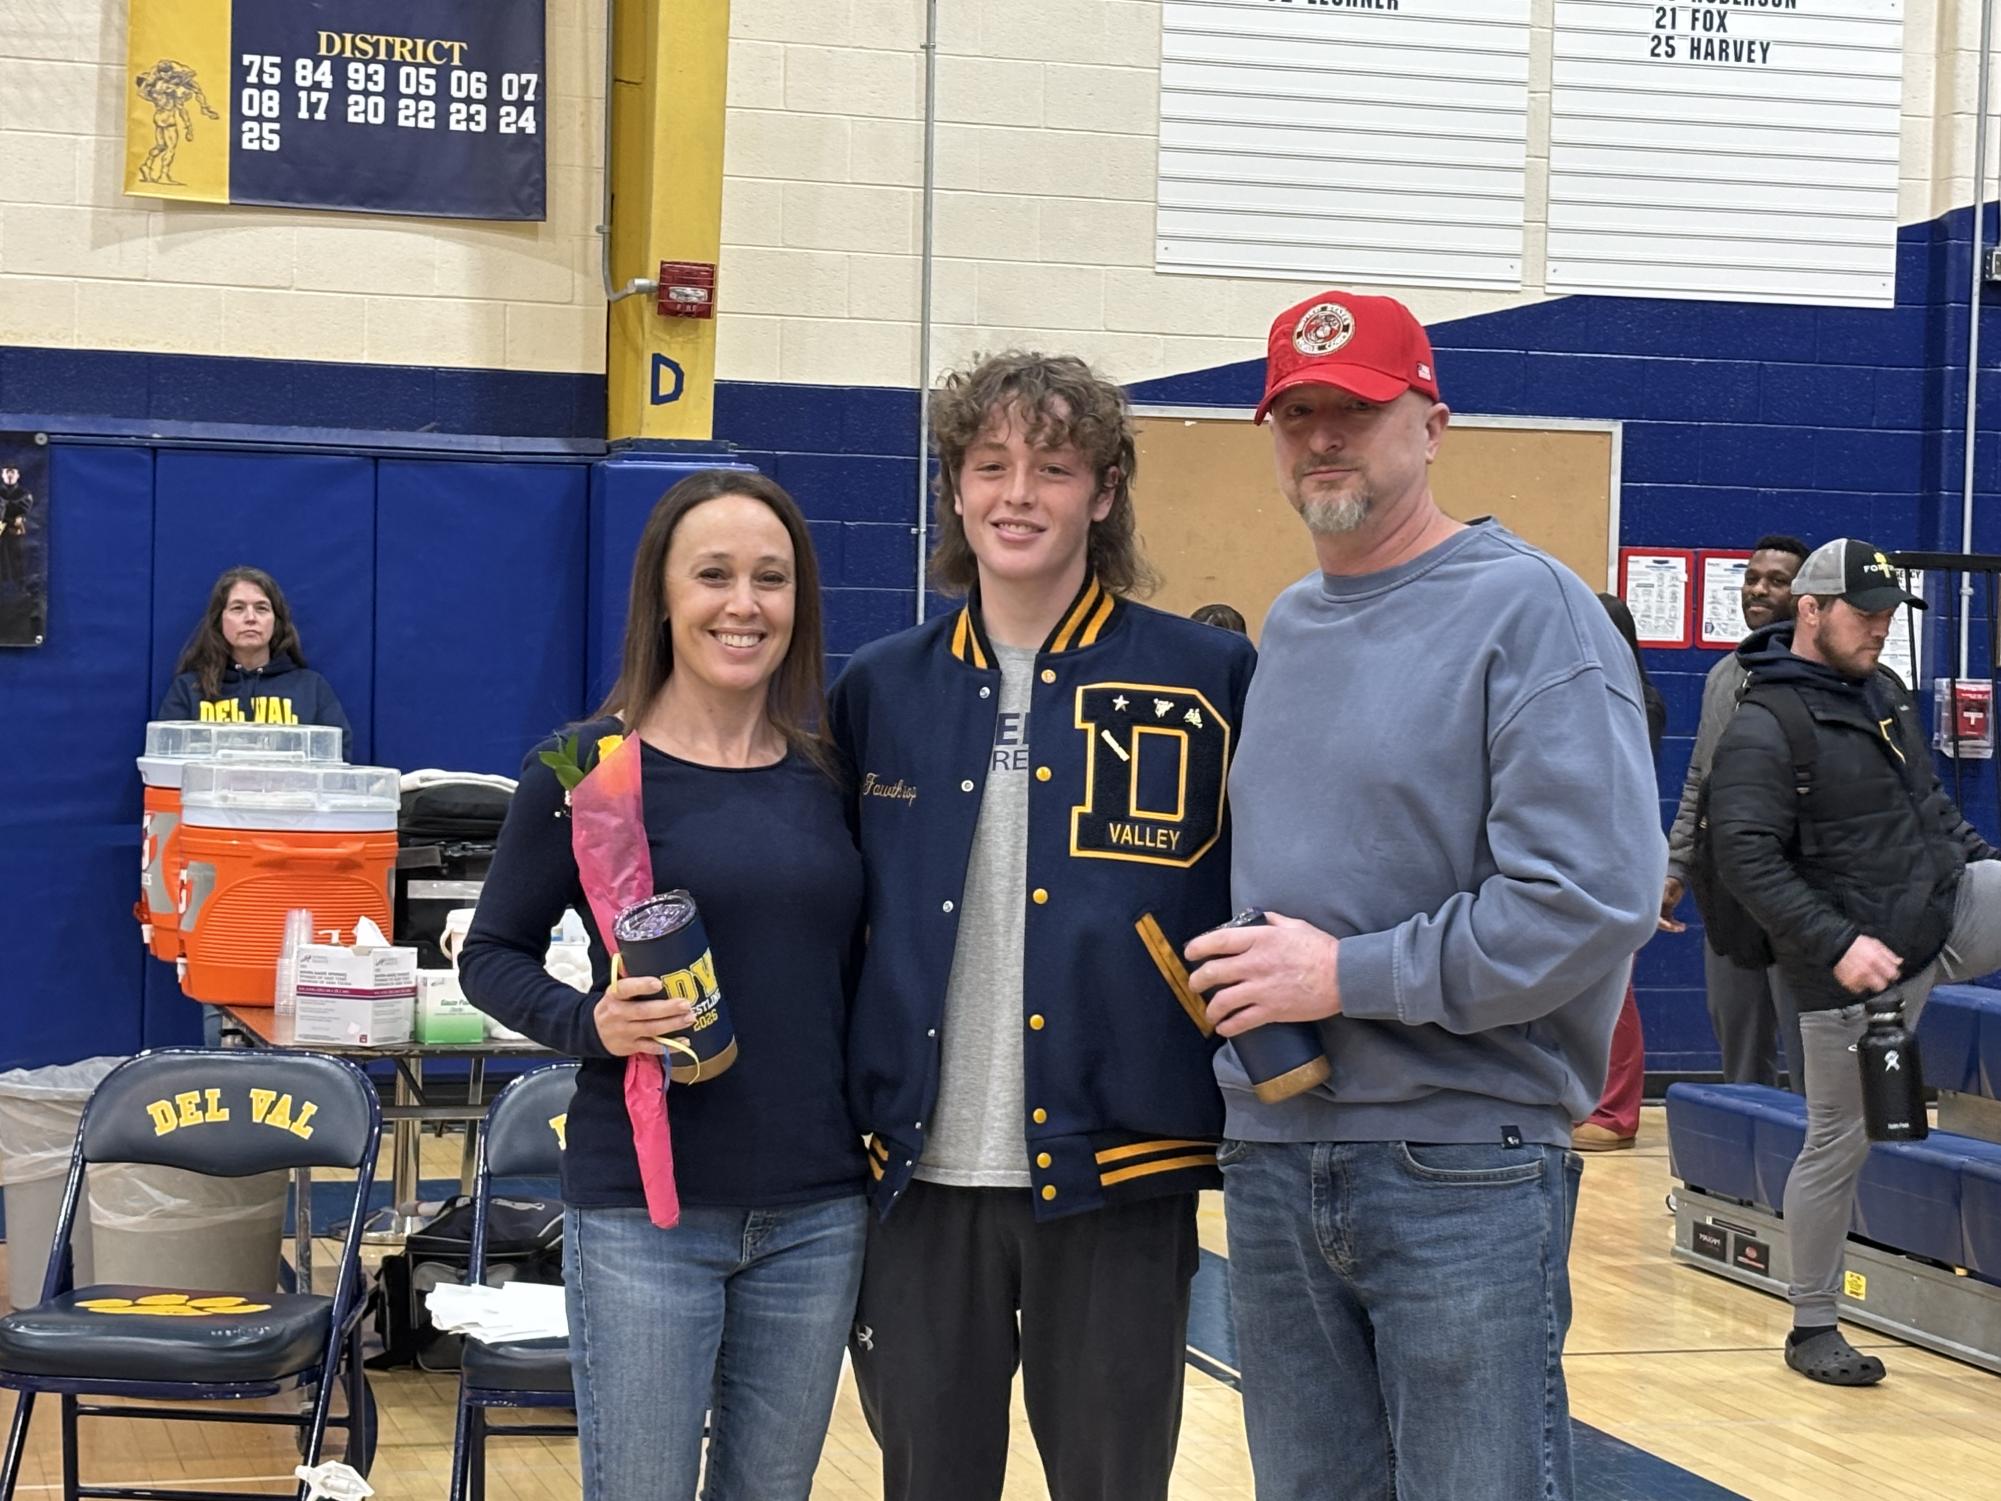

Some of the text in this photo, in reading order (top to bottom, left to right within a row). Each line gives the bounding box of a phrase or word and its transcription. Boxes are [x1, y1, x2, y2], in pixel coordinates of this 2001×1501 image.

[1655, 6, 1728, 33] 21 FOX
[316, 31, 468, 66] DISTRICT
[1650, 35, 1771, 64] 25 HARVEY
[242, 54, 538, 101] 75 84 93 05 06 07
[241, 88, 536, 134] 08 17 20 22 23 24
[241, 121, 280, 151] 25
[650, 353, 685, 405] D
[200, 696, 298, 725] DEL VAL
[1109, 822, 1181, 851] VALLEY
[146, 1088, 318, 1140] DEL VAL
